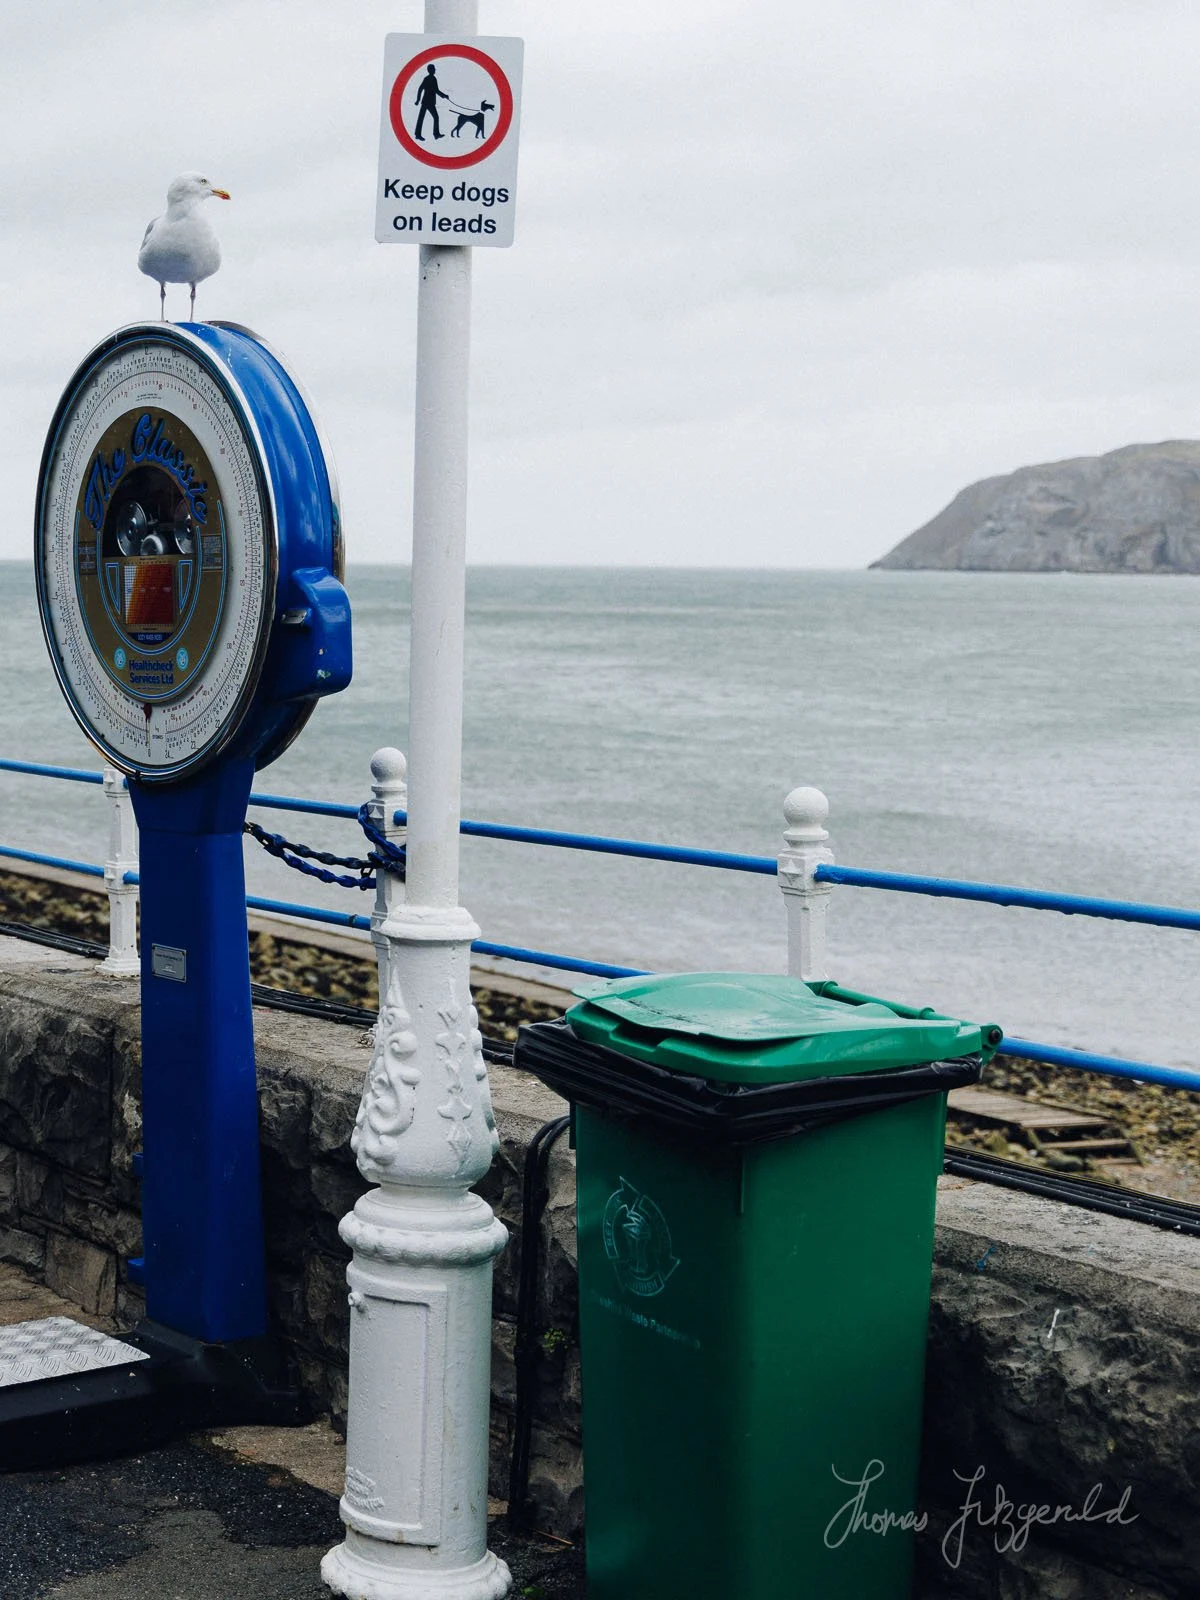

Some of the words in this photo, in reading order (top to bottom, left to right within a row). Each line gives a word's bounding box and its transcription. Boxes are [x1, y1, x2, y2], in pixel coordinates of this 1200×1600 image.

[384, 178, 444, 204] Keep
[451, 182, 509, 207] dogs
[392, 214, 423, 231] on
[431, 212, 497, 234] leads
[84, 447, 125, 531] The
[131, 413, 208, 525] Classic
[128, 659, 174, 672] Healthcheck
[130, 672, 161, 685] Services
[162, 672, 174, 684] Ltd
